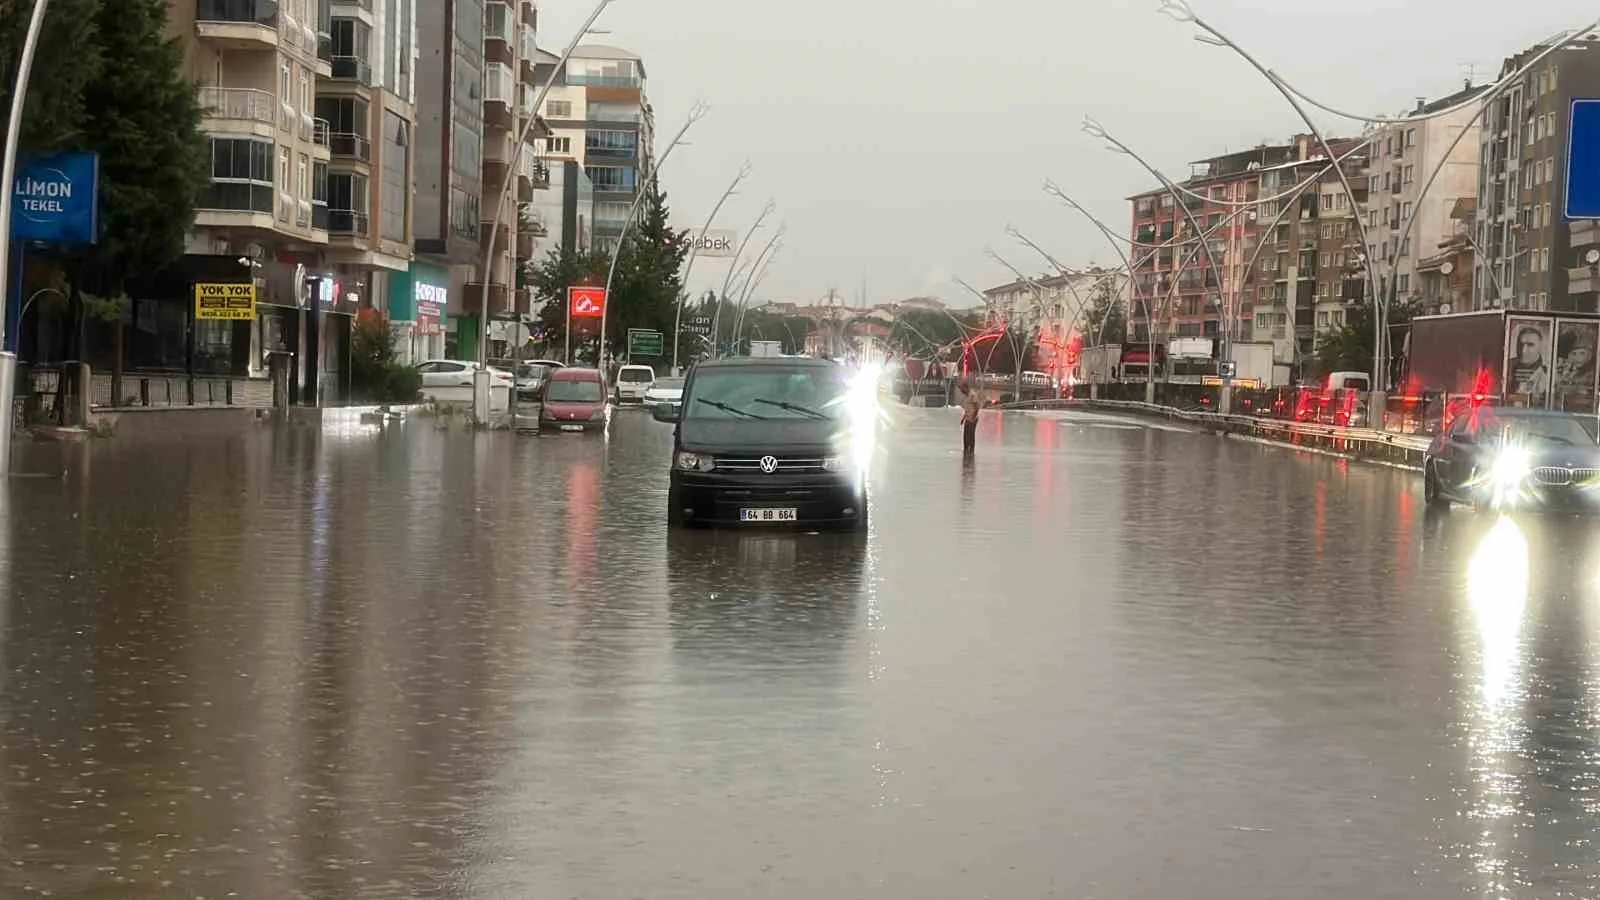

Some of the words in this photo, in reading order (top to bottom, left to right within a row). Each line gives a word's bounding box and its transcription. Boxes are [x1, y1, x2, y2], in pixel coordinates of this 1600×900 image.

[15, 176, 72, 197] LİMON
[22, 199, 64, 212] TEKEL
[200, 286, 224, 295] YOK
[228, 286, 251, 295] YOK
